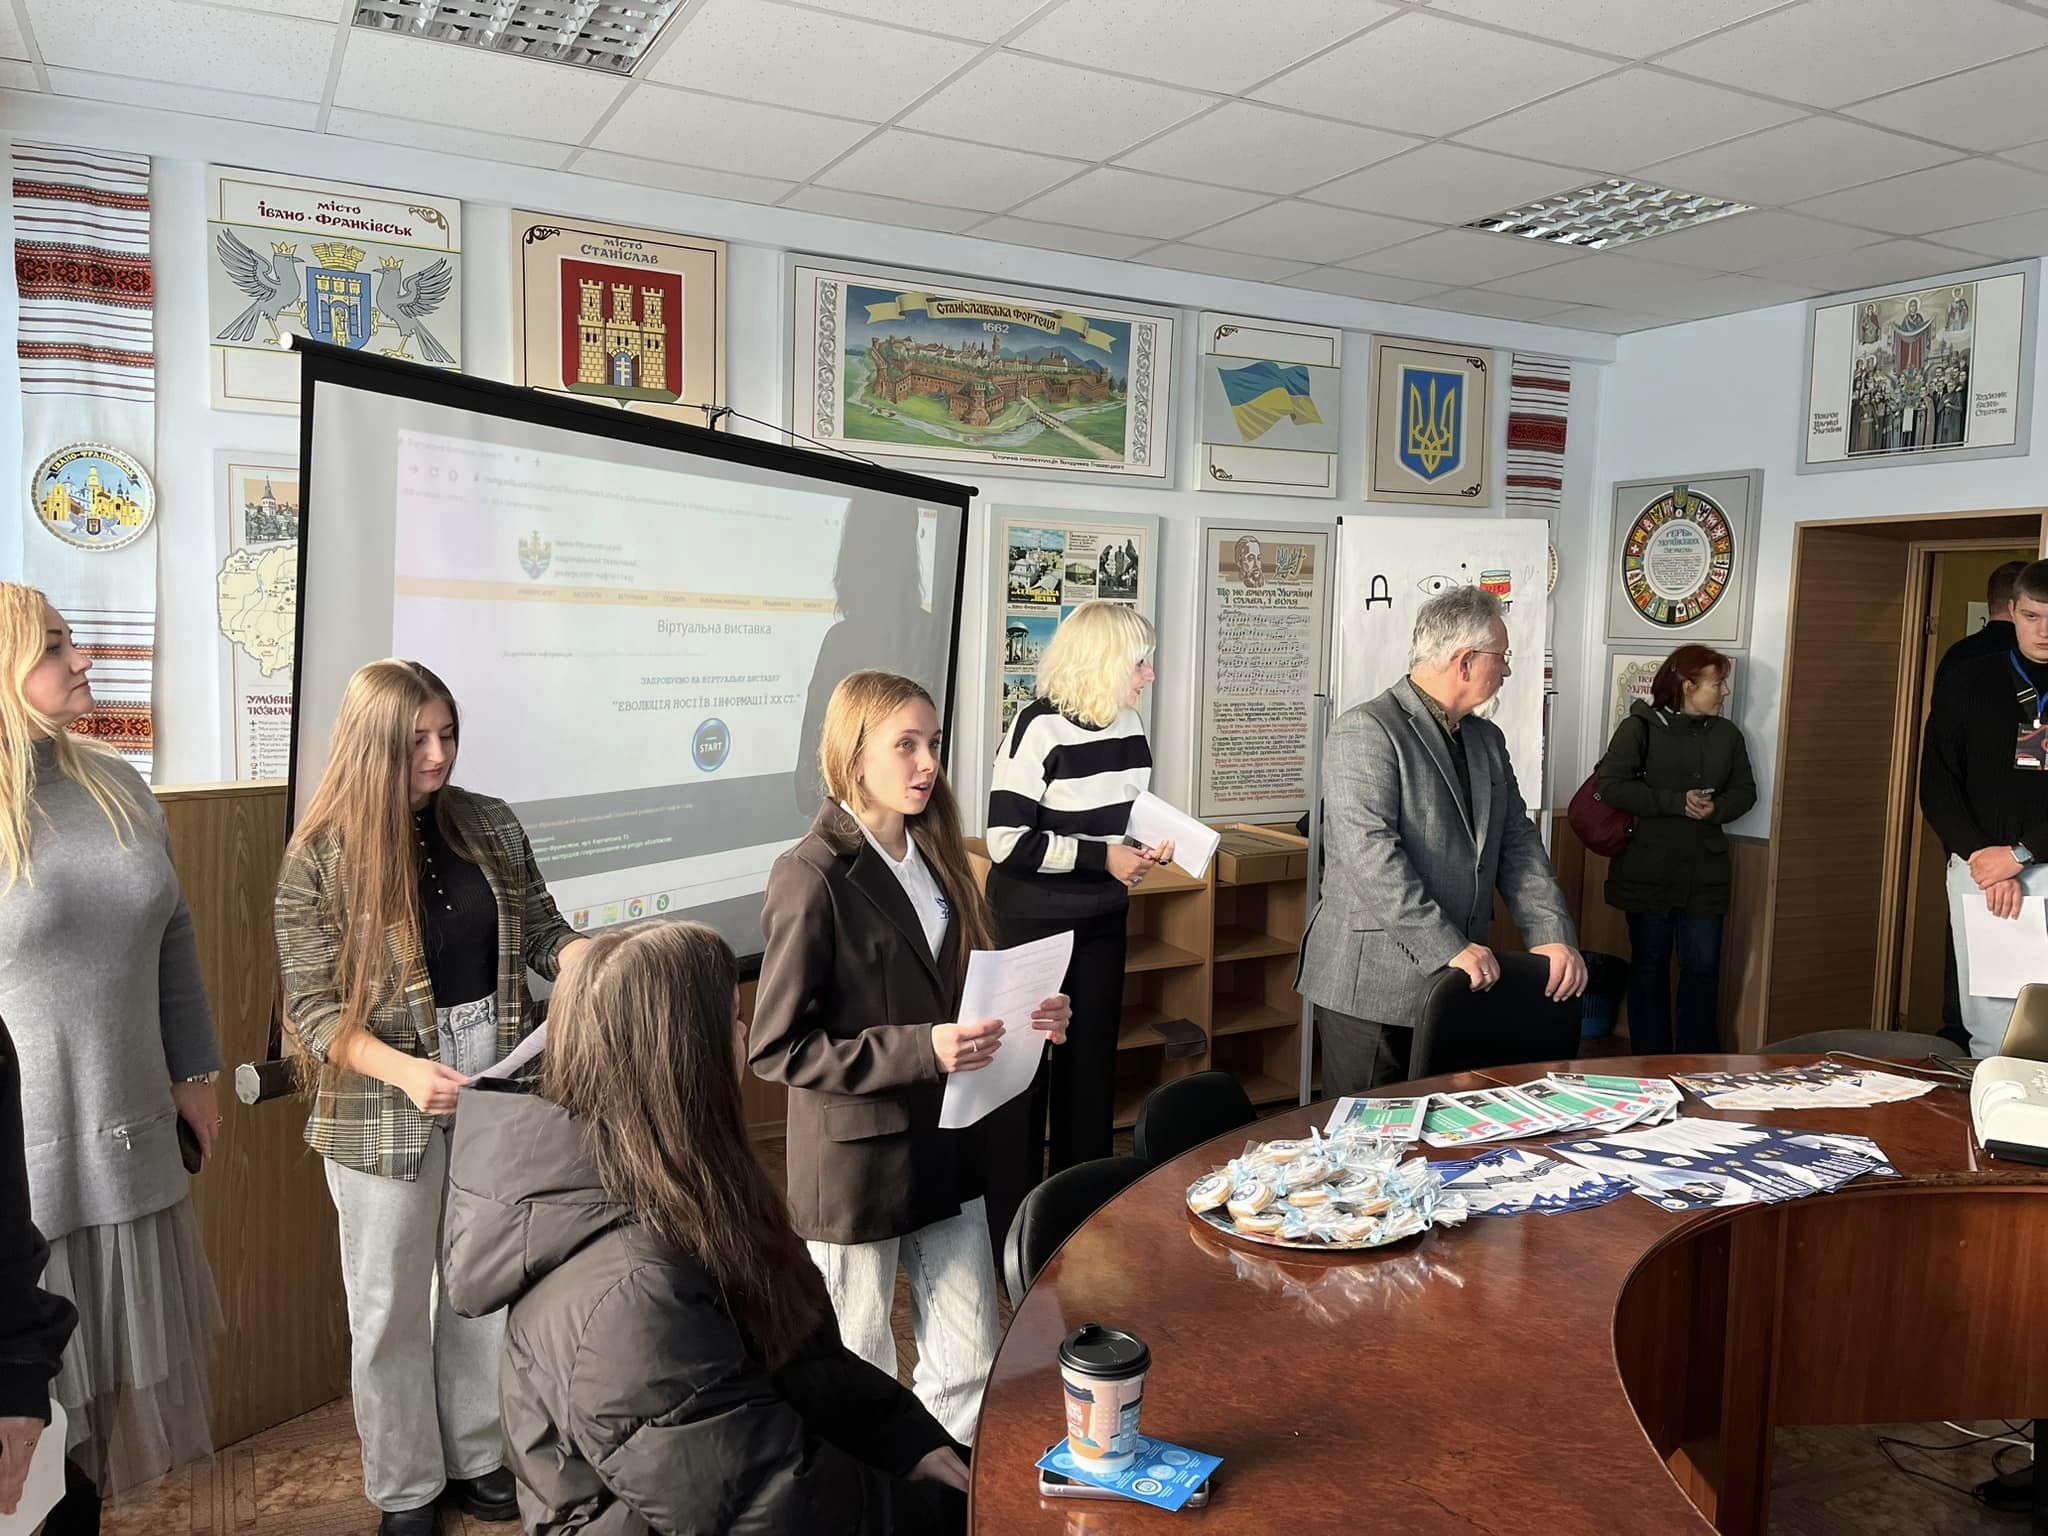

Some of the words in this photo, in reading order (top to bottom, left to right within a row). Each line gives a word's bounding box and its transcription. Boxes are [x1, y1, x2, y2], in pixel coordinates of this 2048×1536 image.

[603, 238, 643, 250] місто
[936, 301, 1012, 318] Станіславська
[1013, 308, 1056, 331] фортеця
[981, 322, 1010, 334] 1662
[657, 619, 721, 637] Віртуальна
[724, 623, 772, 635] виставка
[247, 706, 292, 716] ПОЗНАЧ
[699, 742, 723, 753] START
